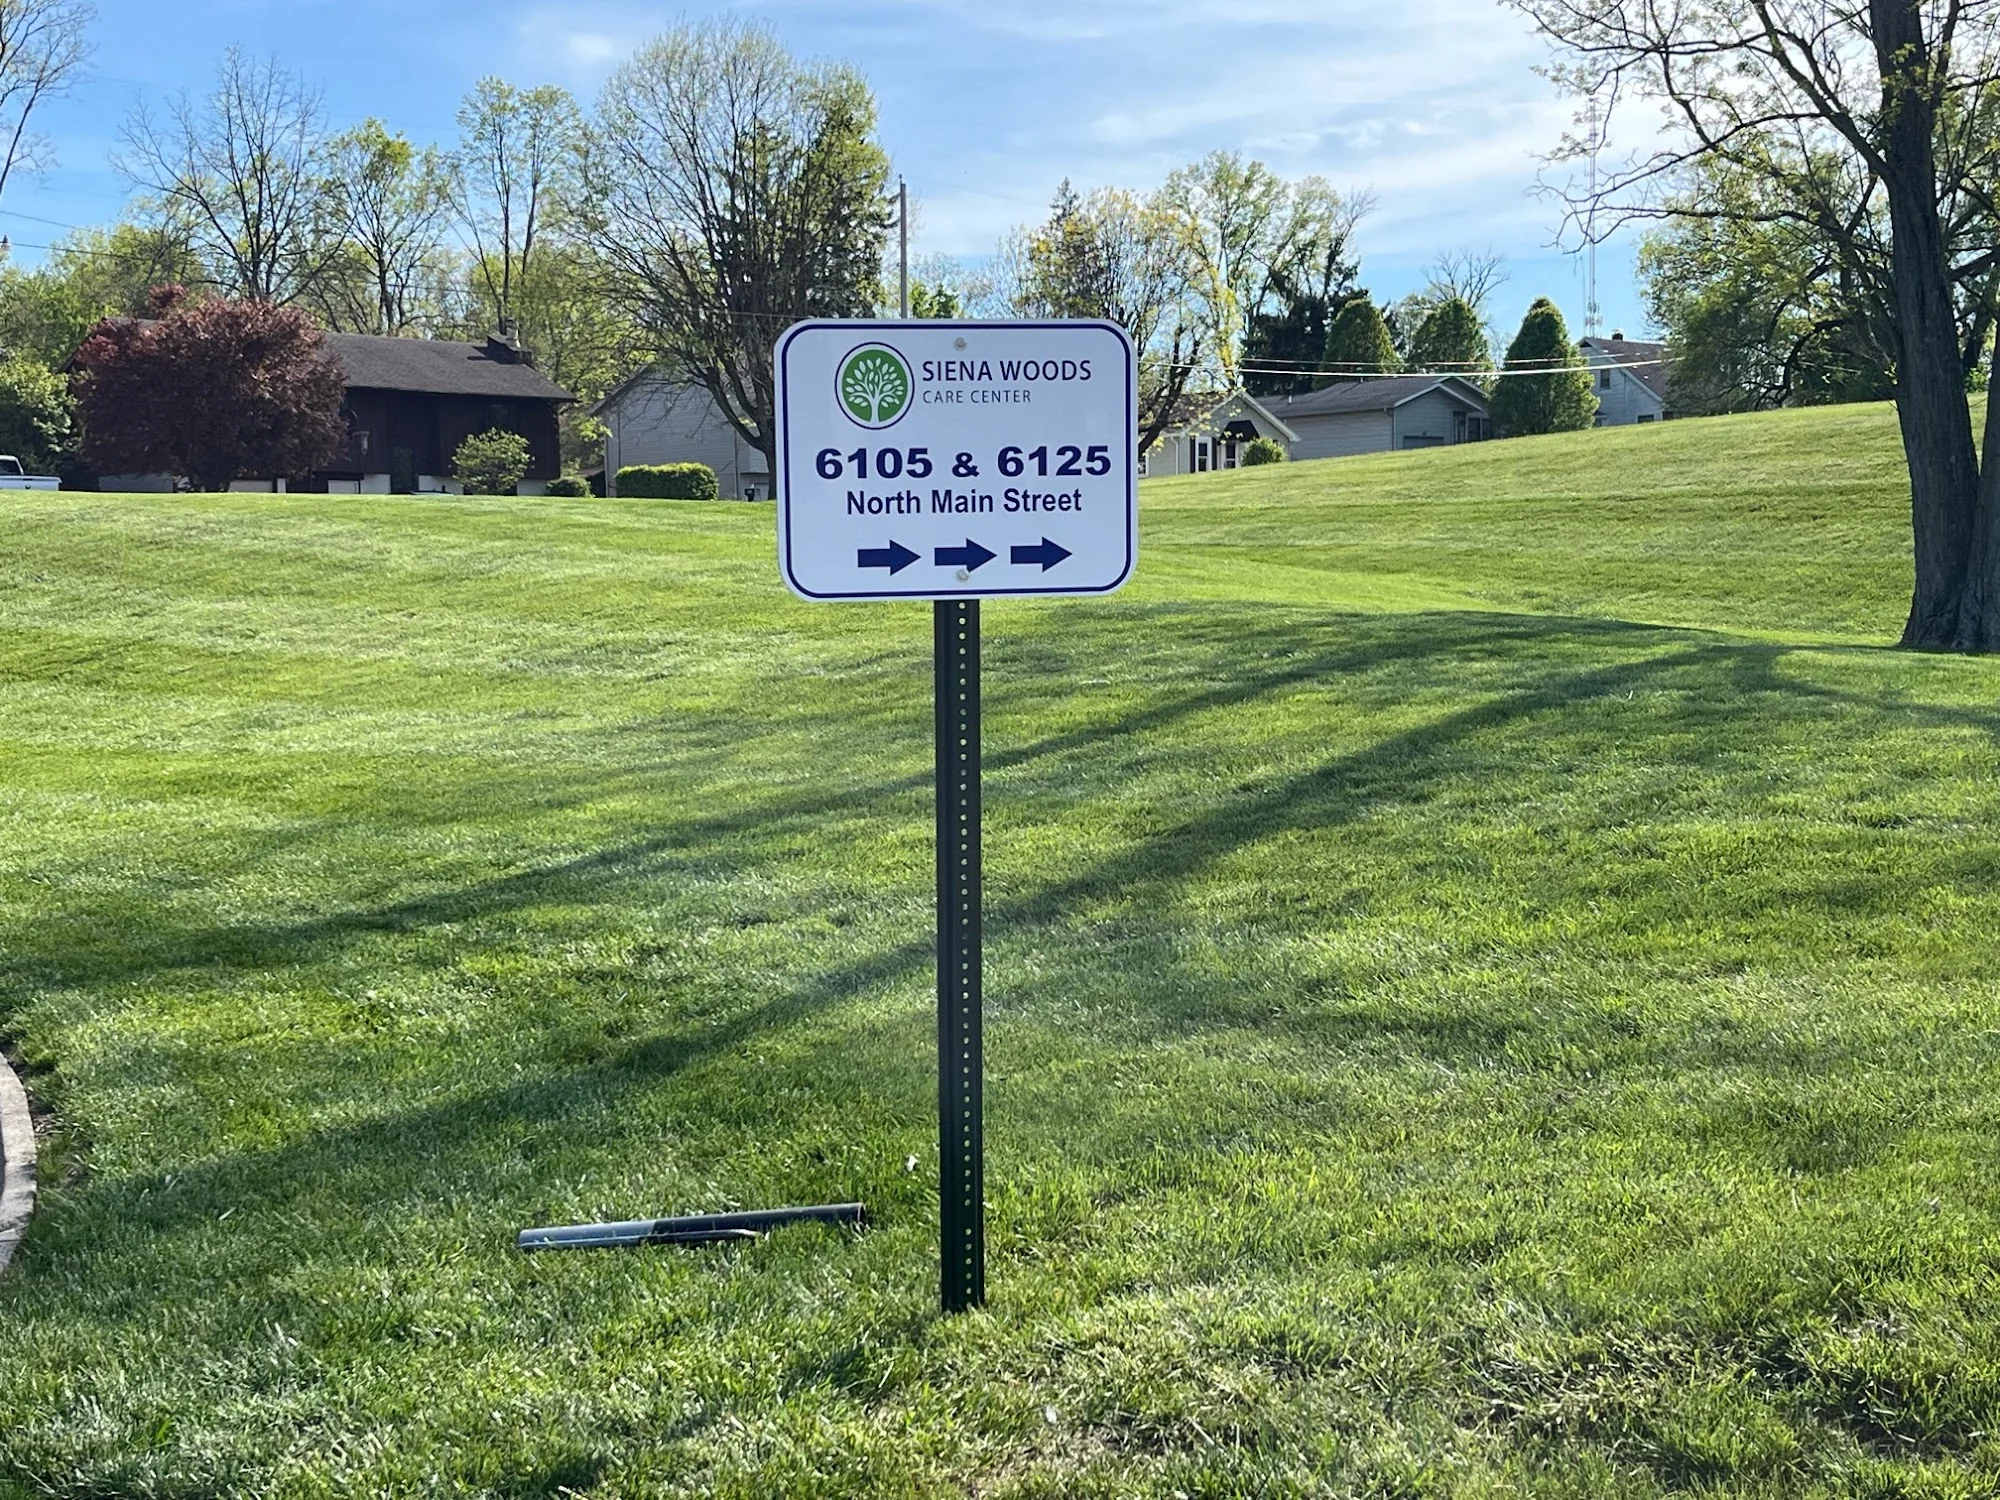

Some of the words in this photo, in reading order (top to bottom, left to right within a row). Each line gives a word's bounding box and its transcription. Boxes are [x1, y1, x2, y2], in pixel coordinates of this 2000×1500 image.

[922, 360, 993, 382] SIENA
[999, 359, 1092, 382] WOODS
[922, 390, 964, 404] CARE
[970, 389, 1031, 404] CENTER
[815, 447, 933, 480] 6105
[951, 451, 980, 478] &
[997, 444, 1112, 478] 6125
[846, 489, 921, 516] North
[931, 488, 994, 514] Main
[1003, 487, 1082, 513] Street
